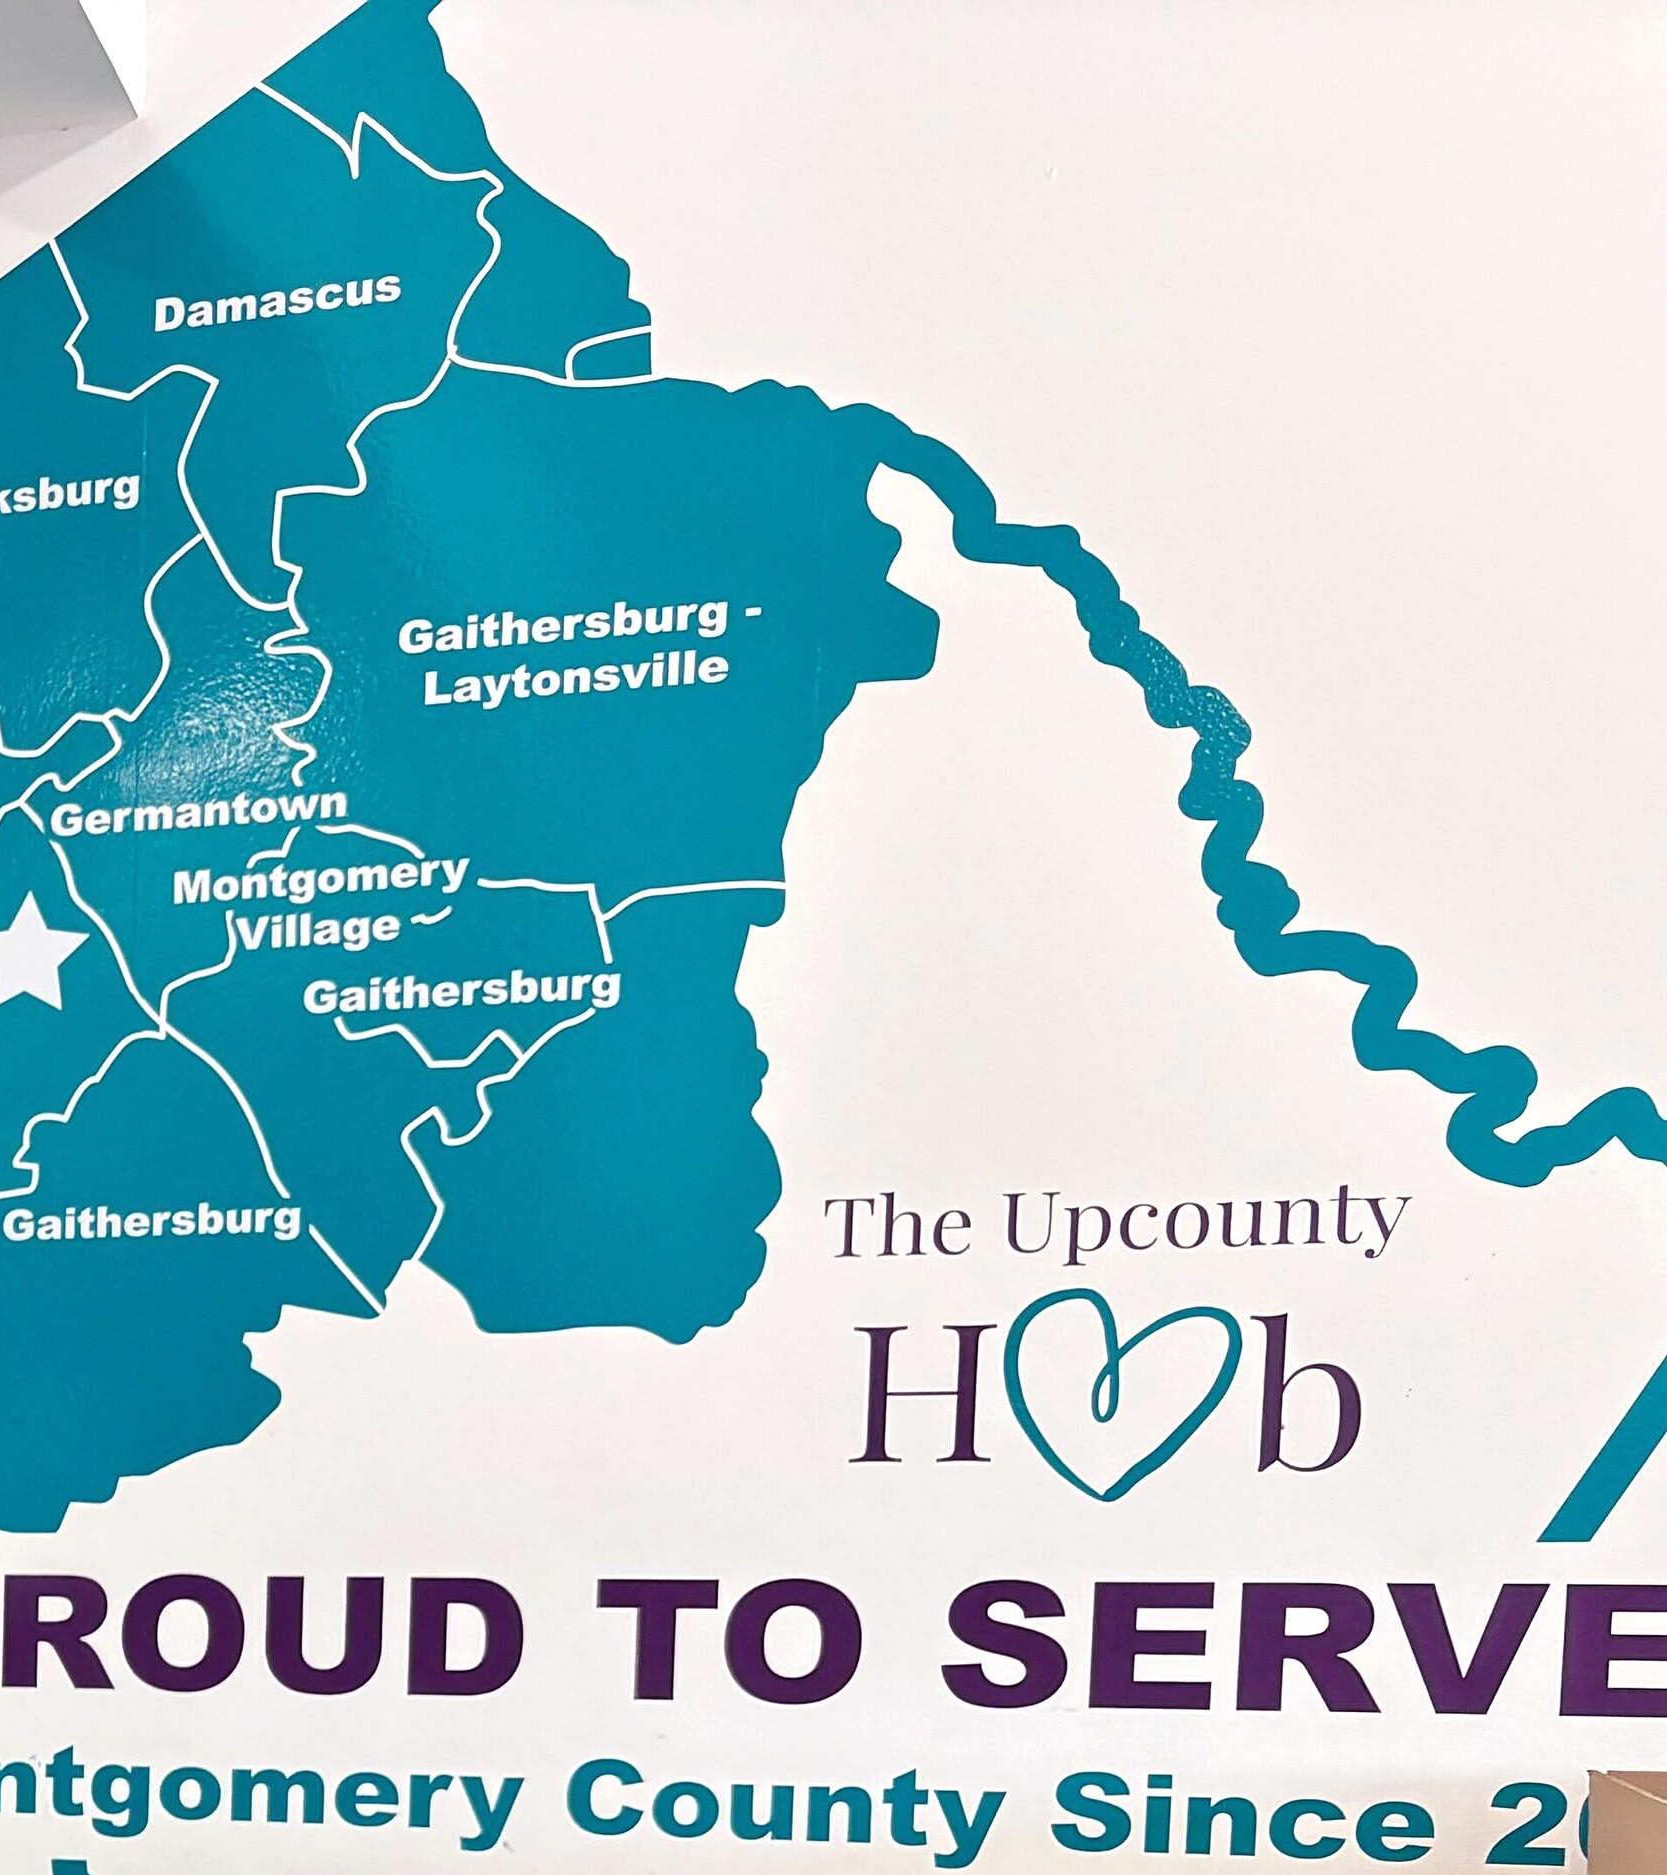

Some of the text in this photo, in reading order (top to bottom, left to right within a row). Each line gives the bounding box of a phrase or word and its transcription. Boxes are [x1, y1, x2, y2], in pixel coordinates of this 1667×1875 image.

[153, 274, 403, 333] Damascus
[397, 600, 729, 655] Gaithersburg
[423, 648, 730, 711] Laytonsville
[49, 790, 349, 838] Germantown
[172, 857, 471, 906] Montgomery
[234, 911, 402, 953] Village
[302, 968, 622, 1015] Gaithersburg
[1, 1201, 302, 1243] Gaithersburg
[823, 1183, 1414, 1268] The Upcounty
[596, 1577, 863, 1706] TO
[940, 1578, 1667, 1719] SERVE
[566, 1757, 1008, 1870] County
[1049, 1770, 1436, 1864] Since
[1483, 1780, 1591, 1868] 2
